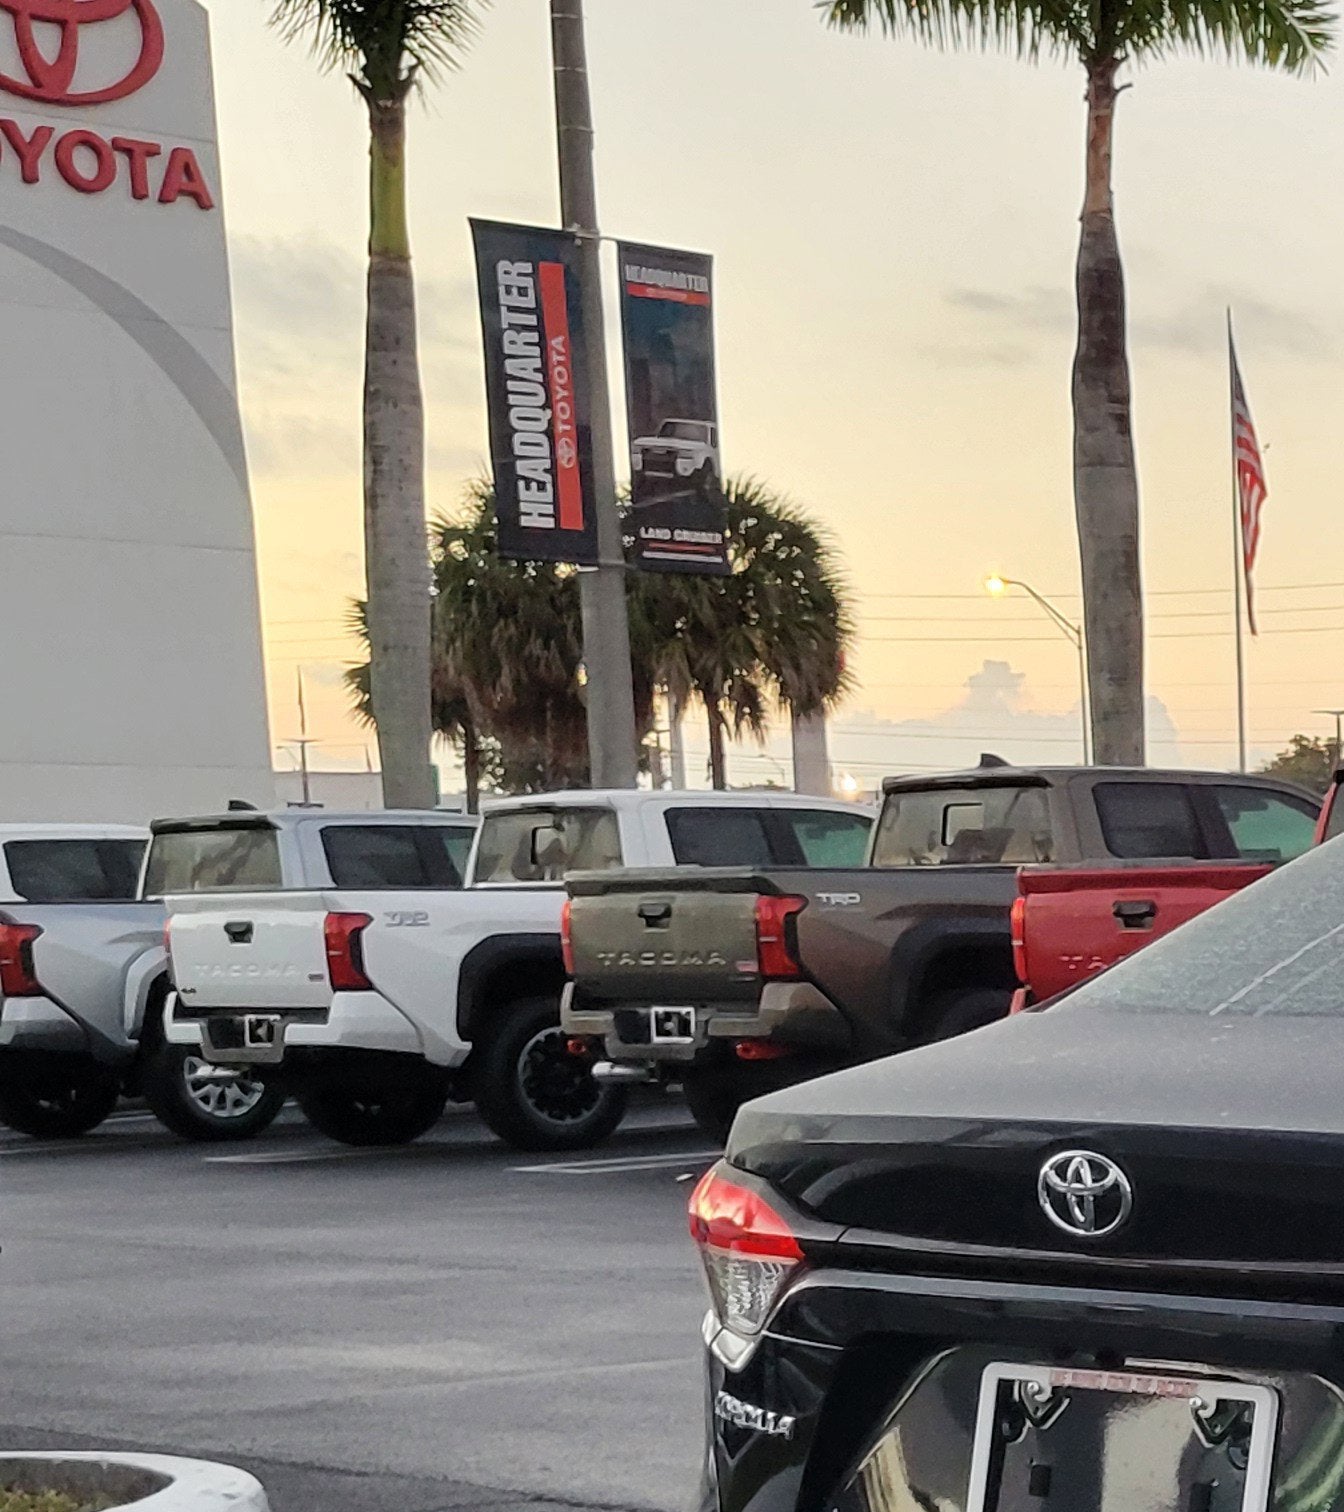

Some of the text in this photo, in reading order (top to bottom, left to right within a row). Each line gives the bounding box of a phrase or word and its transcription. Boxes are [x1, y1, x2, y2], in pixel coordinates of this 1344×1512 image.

[0, 119, 214, 210] YOTA
[497, 259, 556, 529] HEADQUARTER
[551, 335, 576, 433] TOYOTA
[816, 892, 861, 905] TRD
[597, 952, 726, 966] TACOMA
